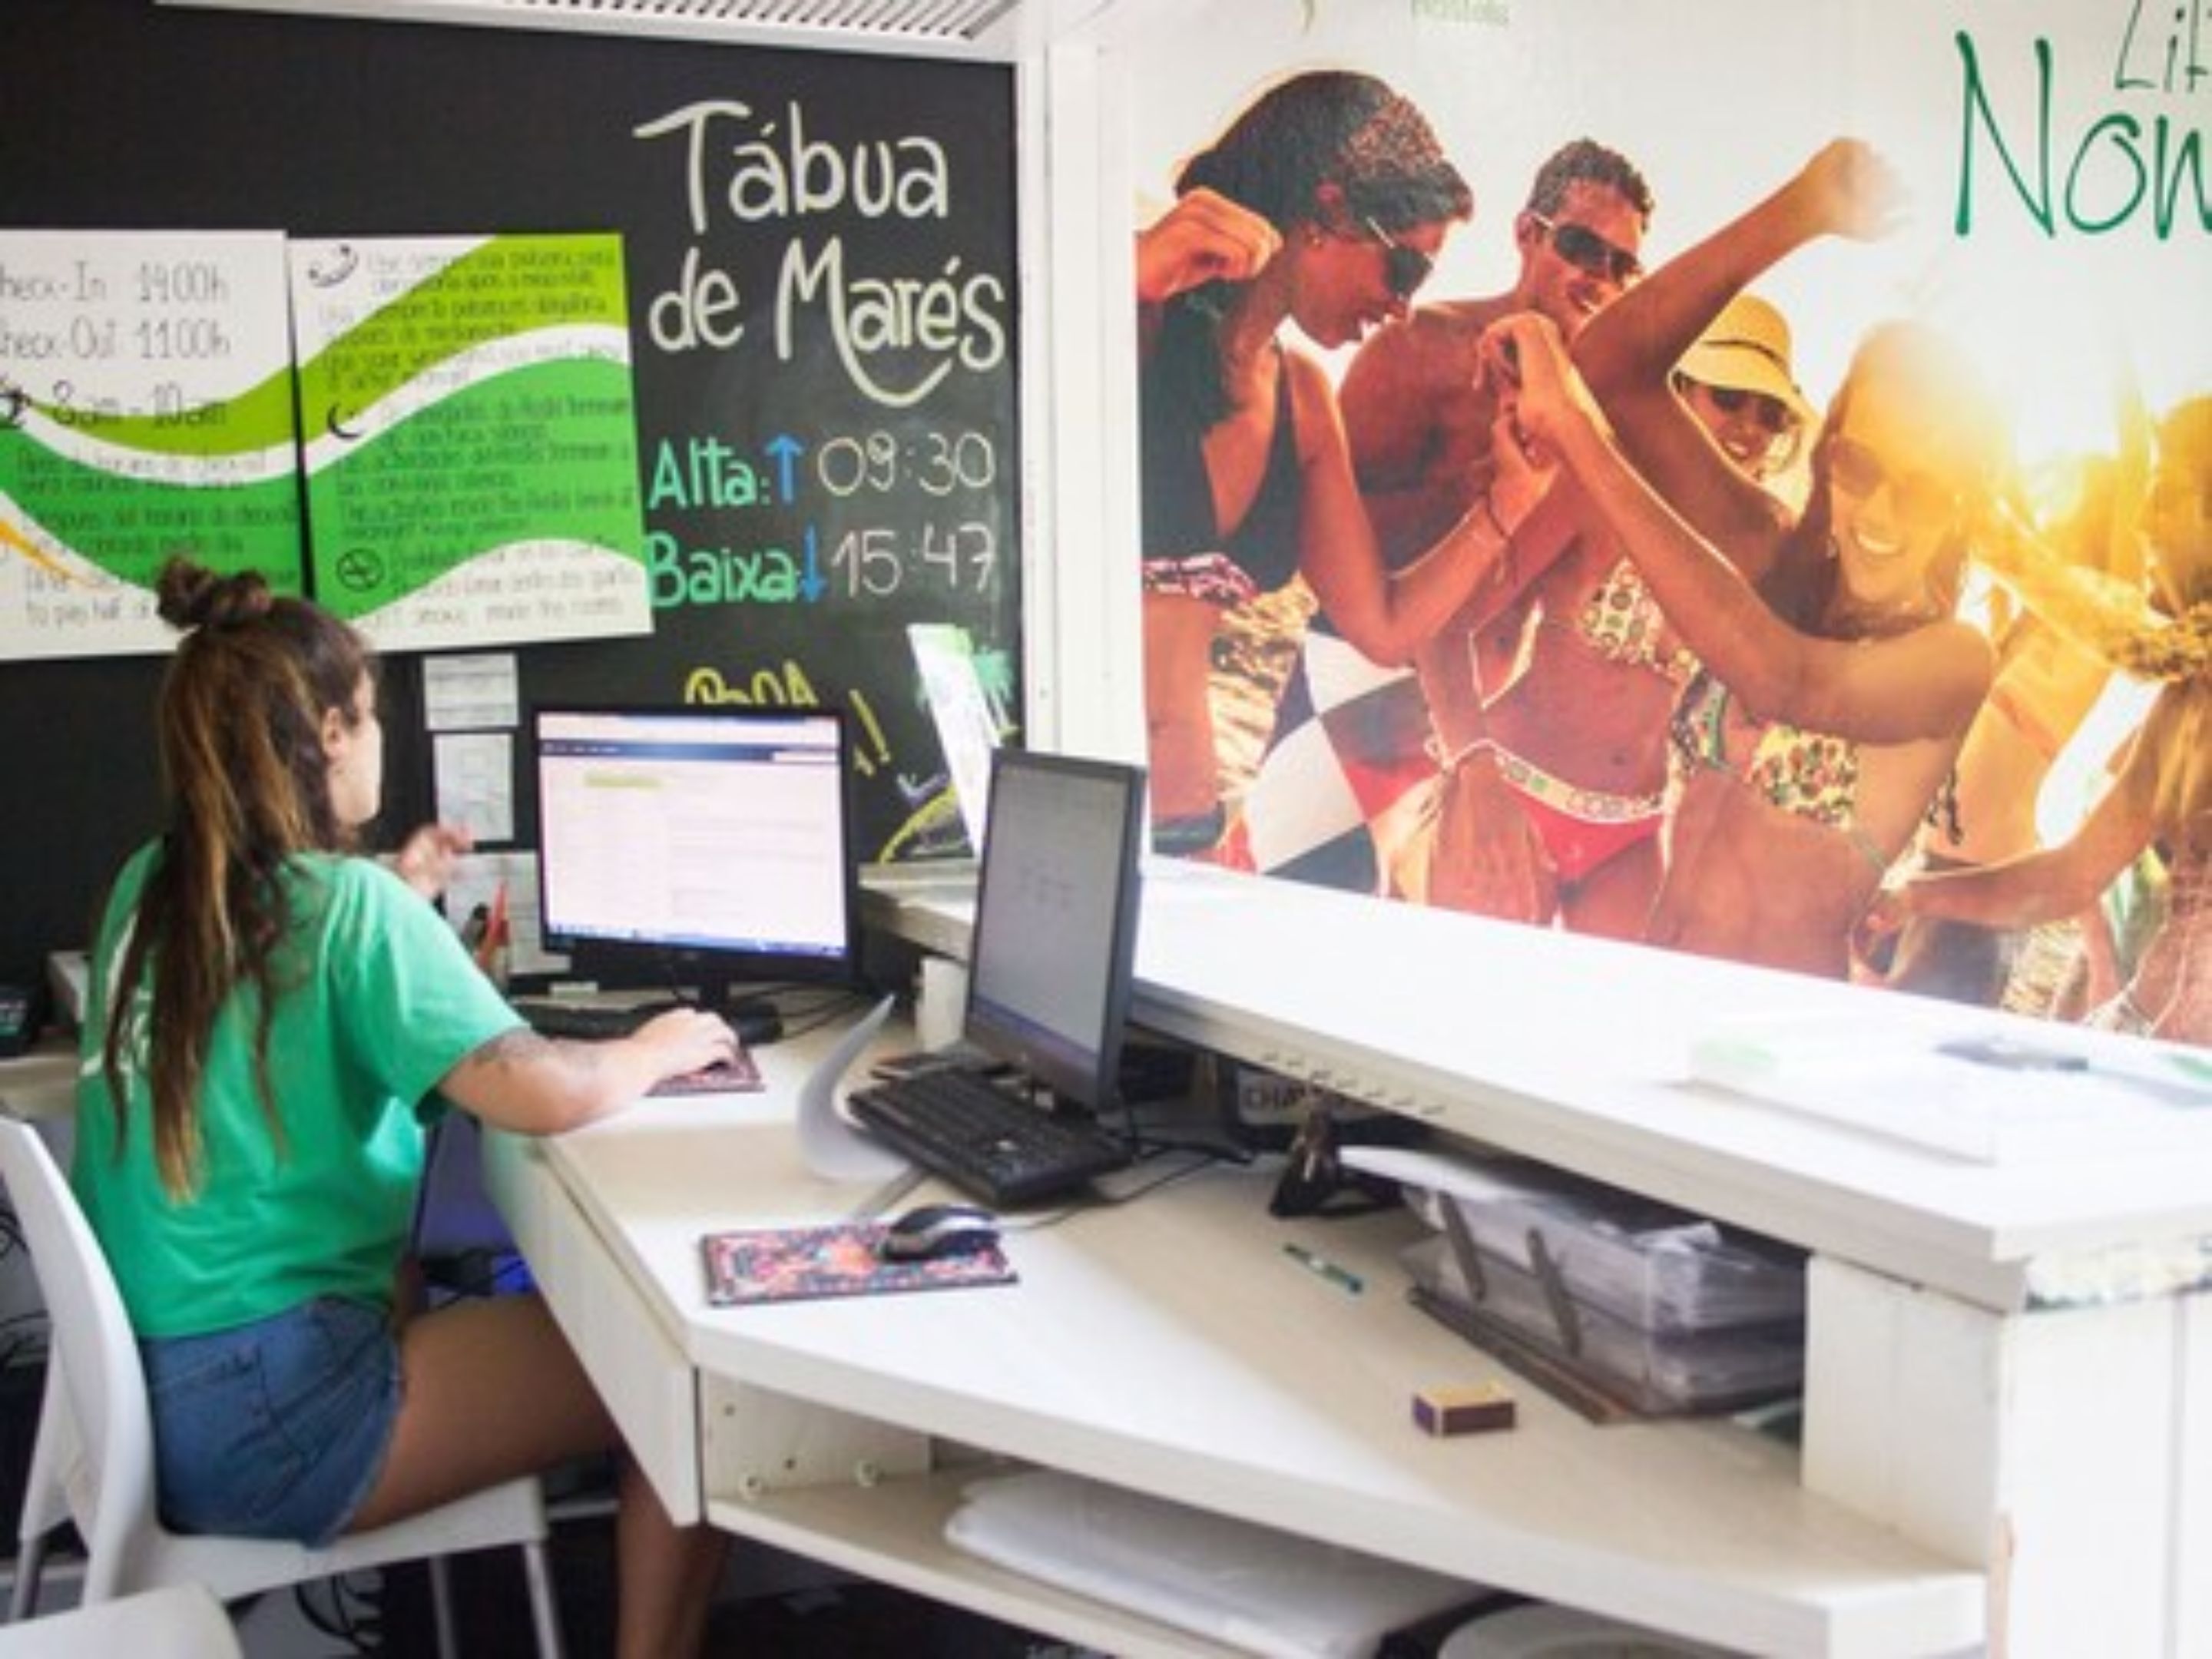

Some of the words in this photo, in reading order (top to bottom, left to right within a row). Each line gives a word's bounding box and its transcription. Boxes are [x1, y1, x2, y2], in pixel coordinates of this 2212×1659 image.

[632, 100, 949, 234] Tábua
[648, 247, 744, 352] de
[774, 237, 1005, 408] Marés
[816, 430, 996, 498] 09:30
[830, 521, 997, 598] 15:47
